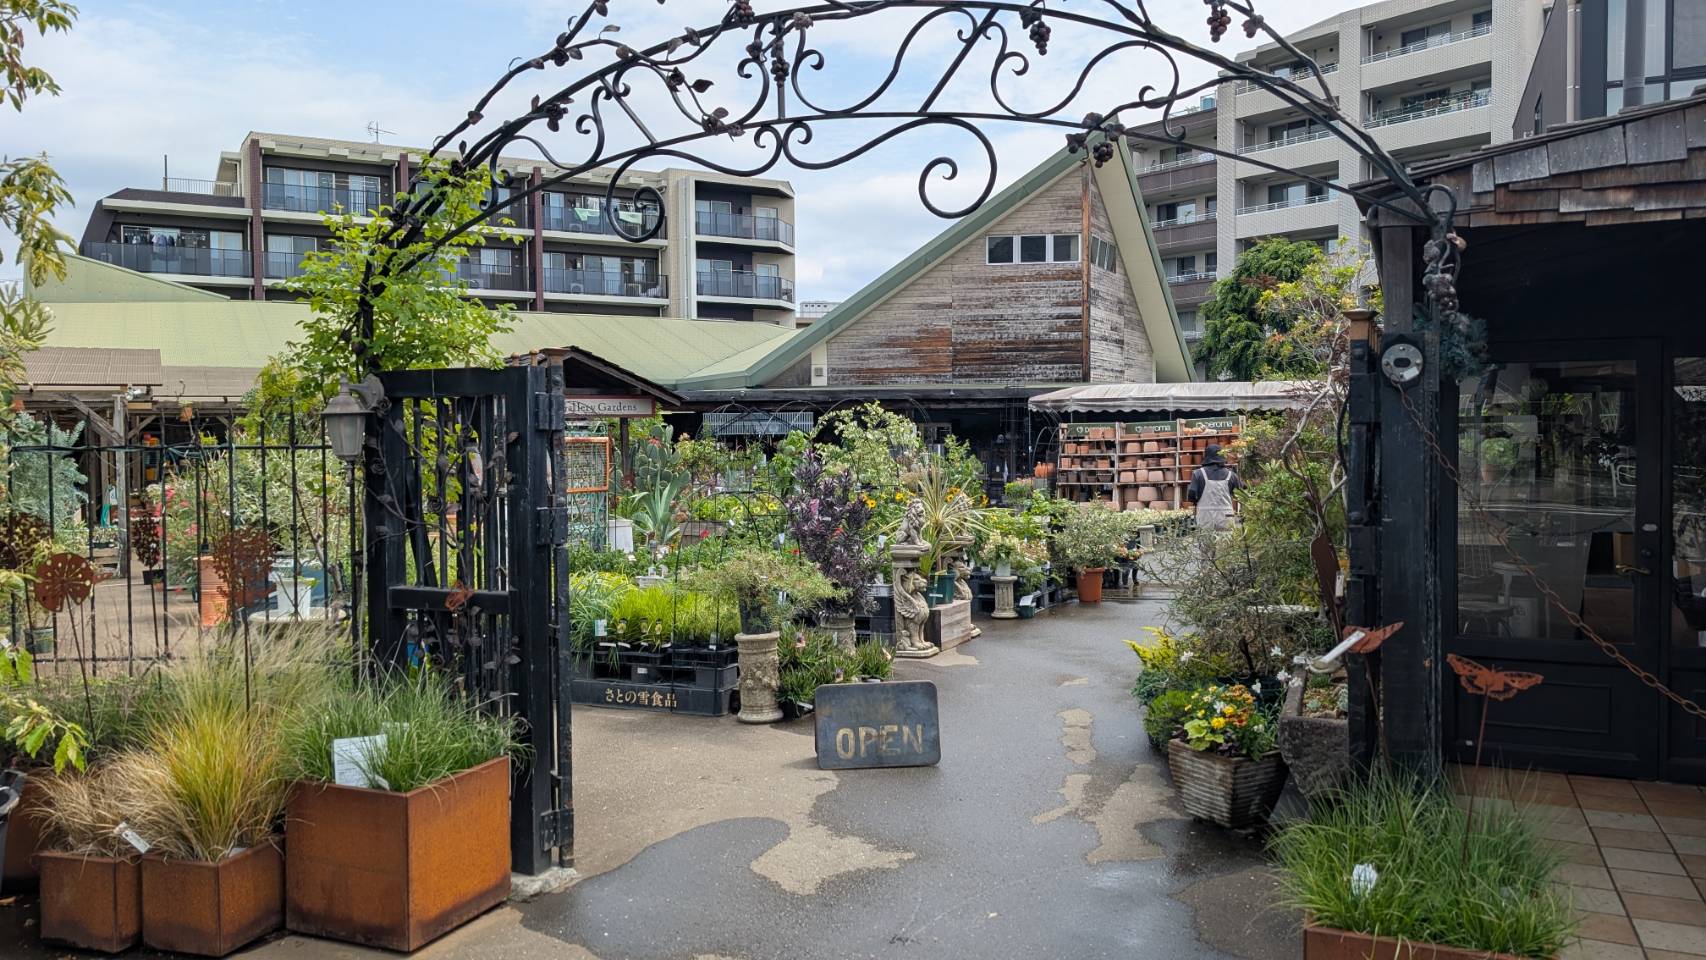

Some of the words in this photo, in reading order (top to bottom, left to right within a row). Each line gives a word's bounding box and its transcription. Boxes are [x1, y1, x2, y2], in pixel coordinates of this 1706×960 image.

[598, 402, 637, 412] Gardens
[605, 687, 677, 708] さとの雪食品
[835, 723, 923, 760] OPEN
